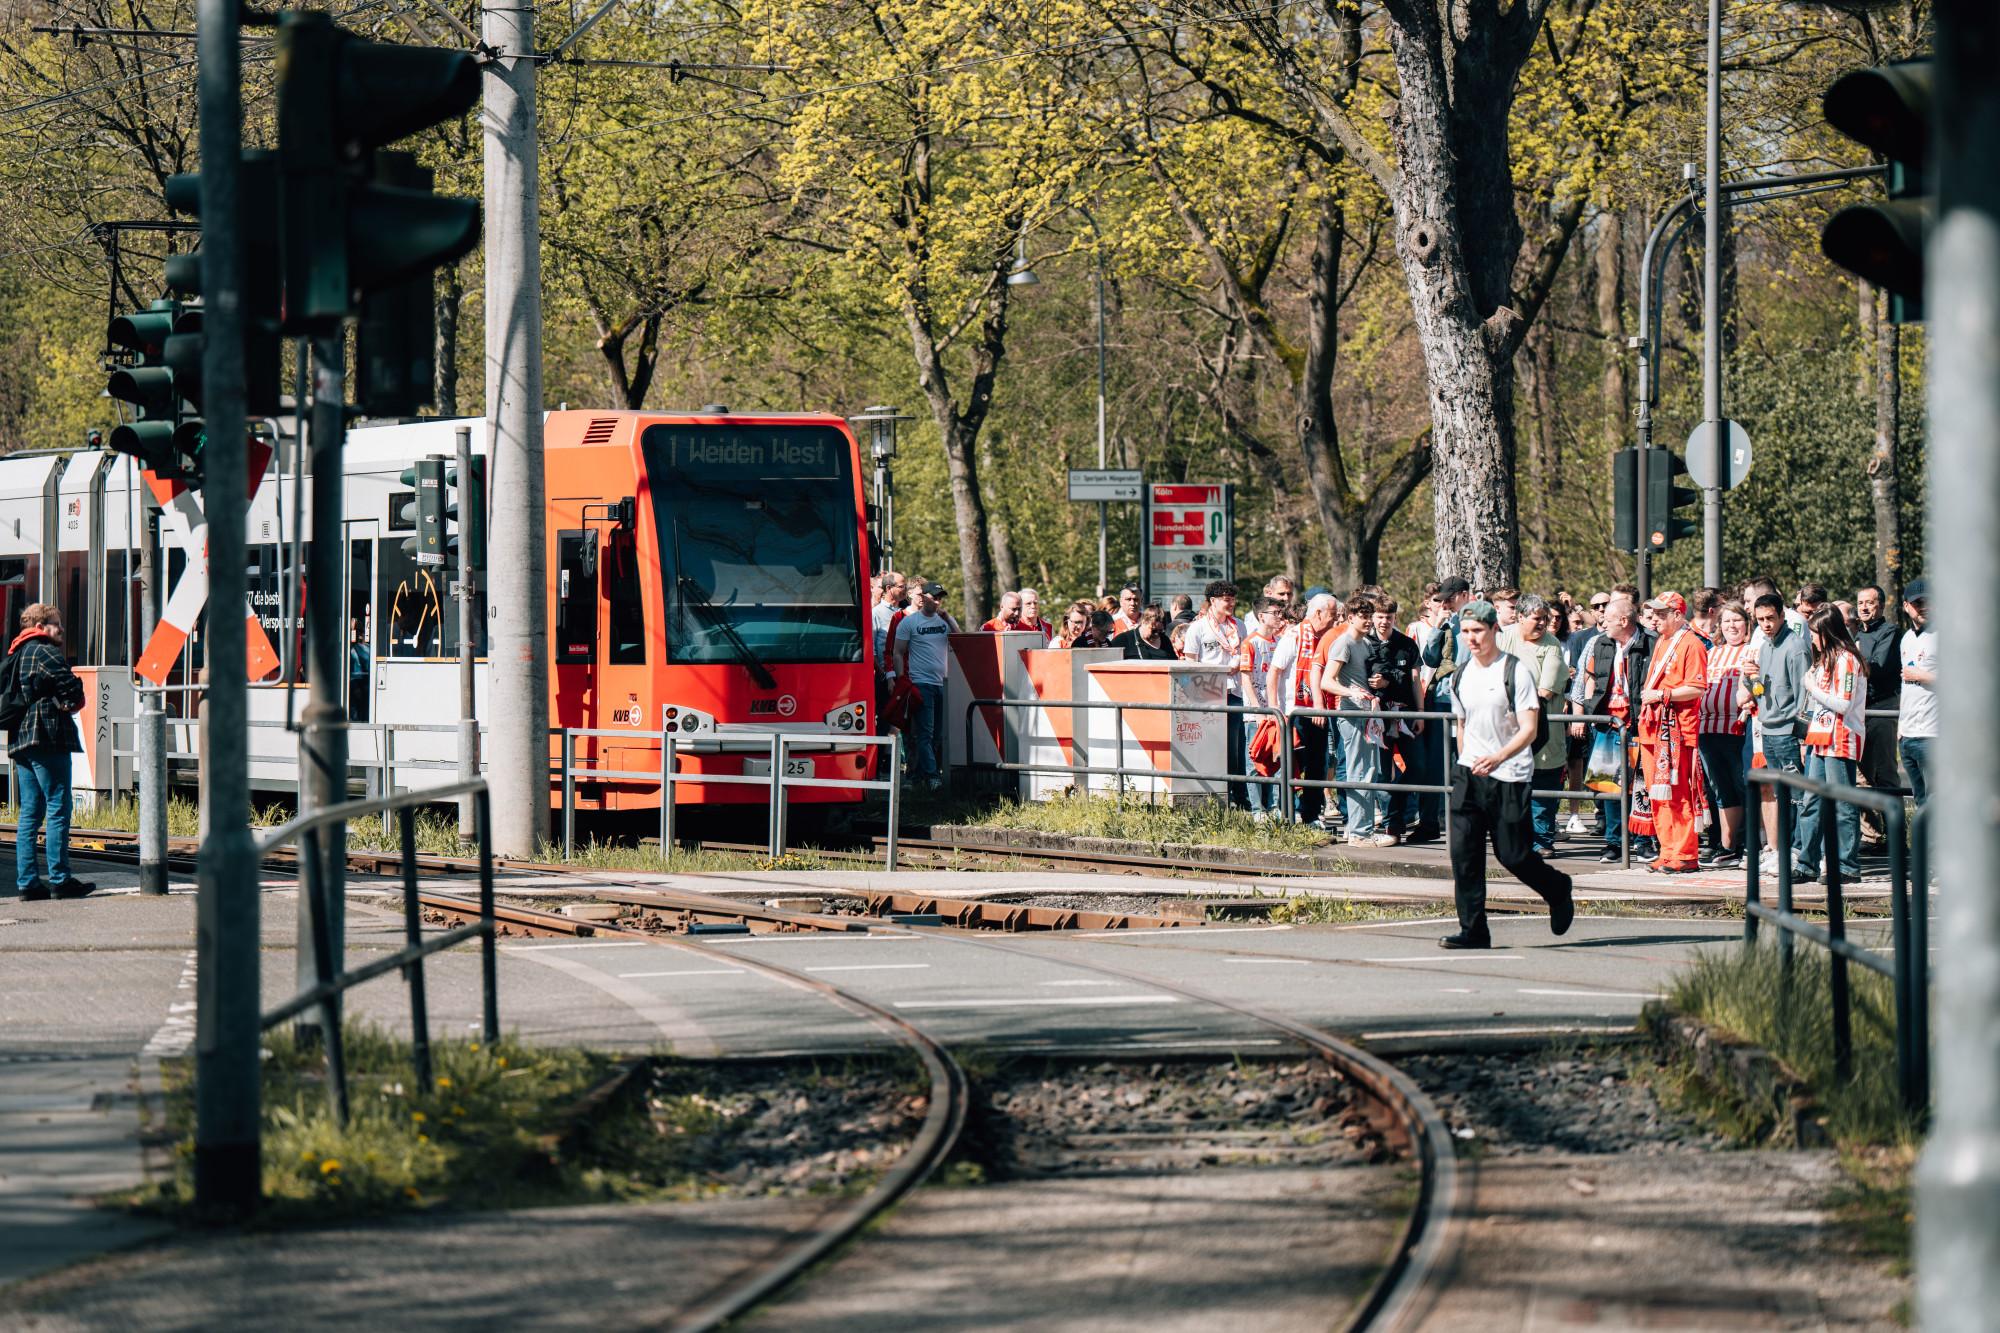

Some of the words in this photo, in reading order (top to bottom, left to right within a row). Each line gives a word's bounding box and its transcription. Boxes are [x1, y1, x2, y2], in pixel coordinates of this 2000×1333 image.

[669, 435, 677, 466] 1
[689, 436, 764, 464] Weiden
[772, 437, 826, 464] West
[1155, 488, 1173, 496] Köln
[1155, 524, 1204, 532] Handelshof
[254, 590, 264, 606] die
[750, 699, 778, 713] KVB
[613, 710, 630, 722] KVB
